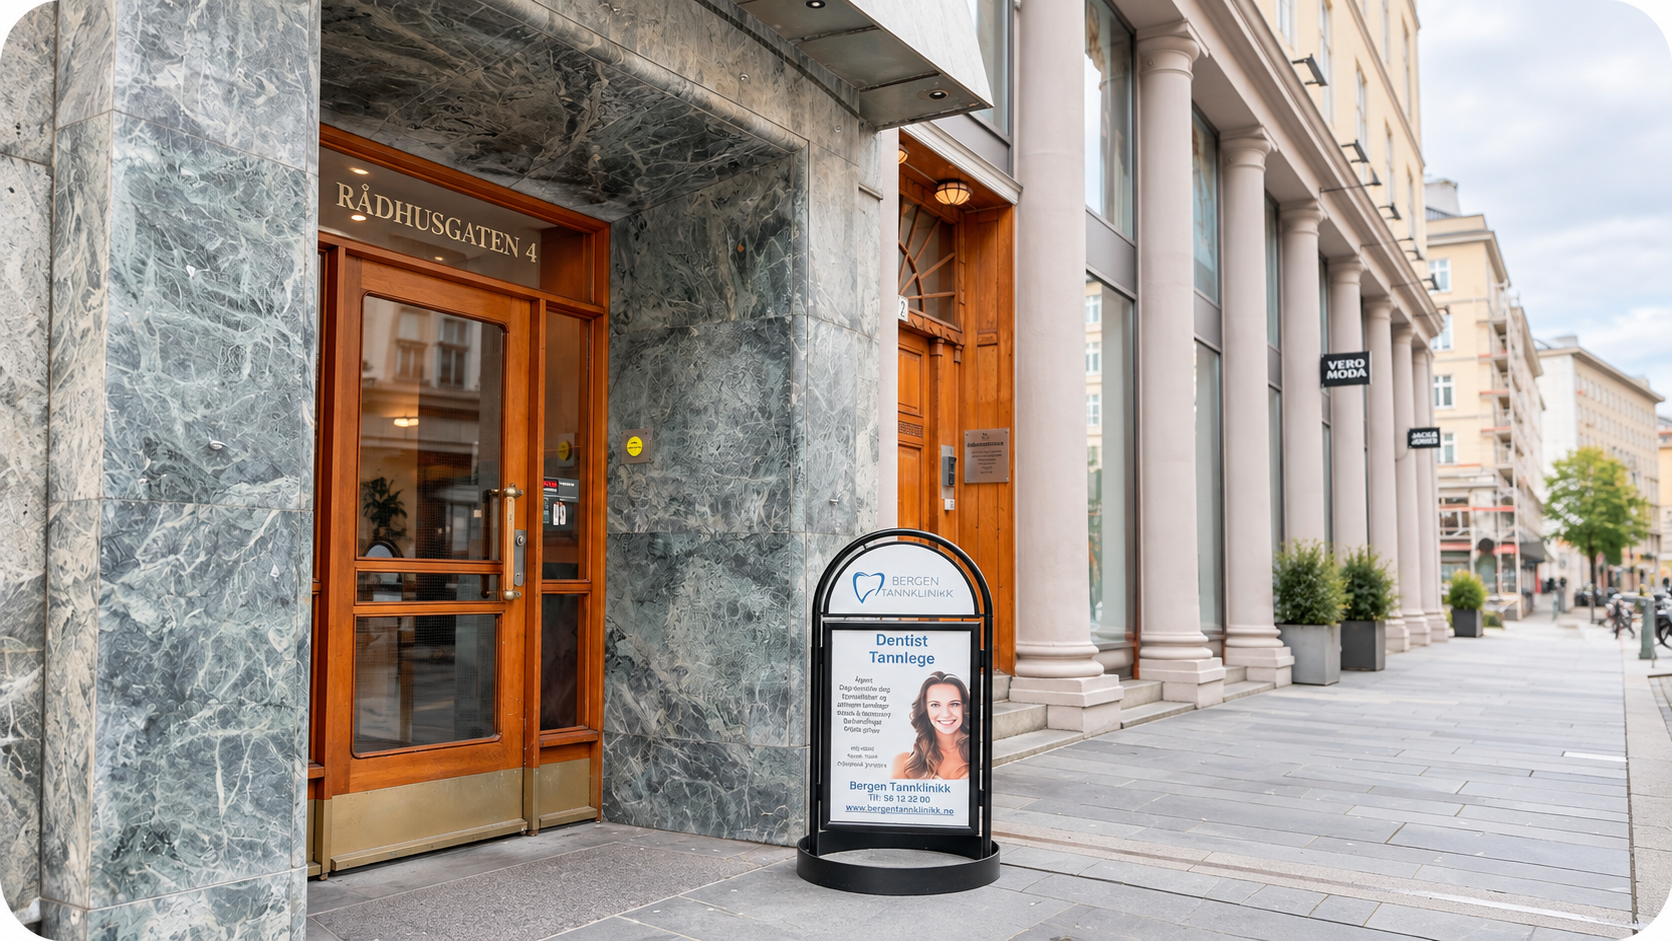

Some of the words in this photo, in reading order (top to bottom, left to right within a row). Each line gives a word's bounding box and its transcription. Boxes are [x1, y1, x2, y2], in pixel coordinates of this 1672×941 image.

[336, 181, 520, 258] RÅDHUSGATEN
[525, 242, 537, 263] 4
[1327, 358, 1366, 370] VERO
[1326, 368, 1368, 380] MODA
[892, 576, 940, 586] BERGEN
[882, 588, 954, 598] TANNKLINIKK
[876, 634, 928, 647] Dentist
[869, 651, 935, 668] Tannlege
[850, 781, 886, 792] Bergen
[890, 782, 951, 793] Tannklinikk
[846, 804, 954, 816] www.bergentannklinikk.no
